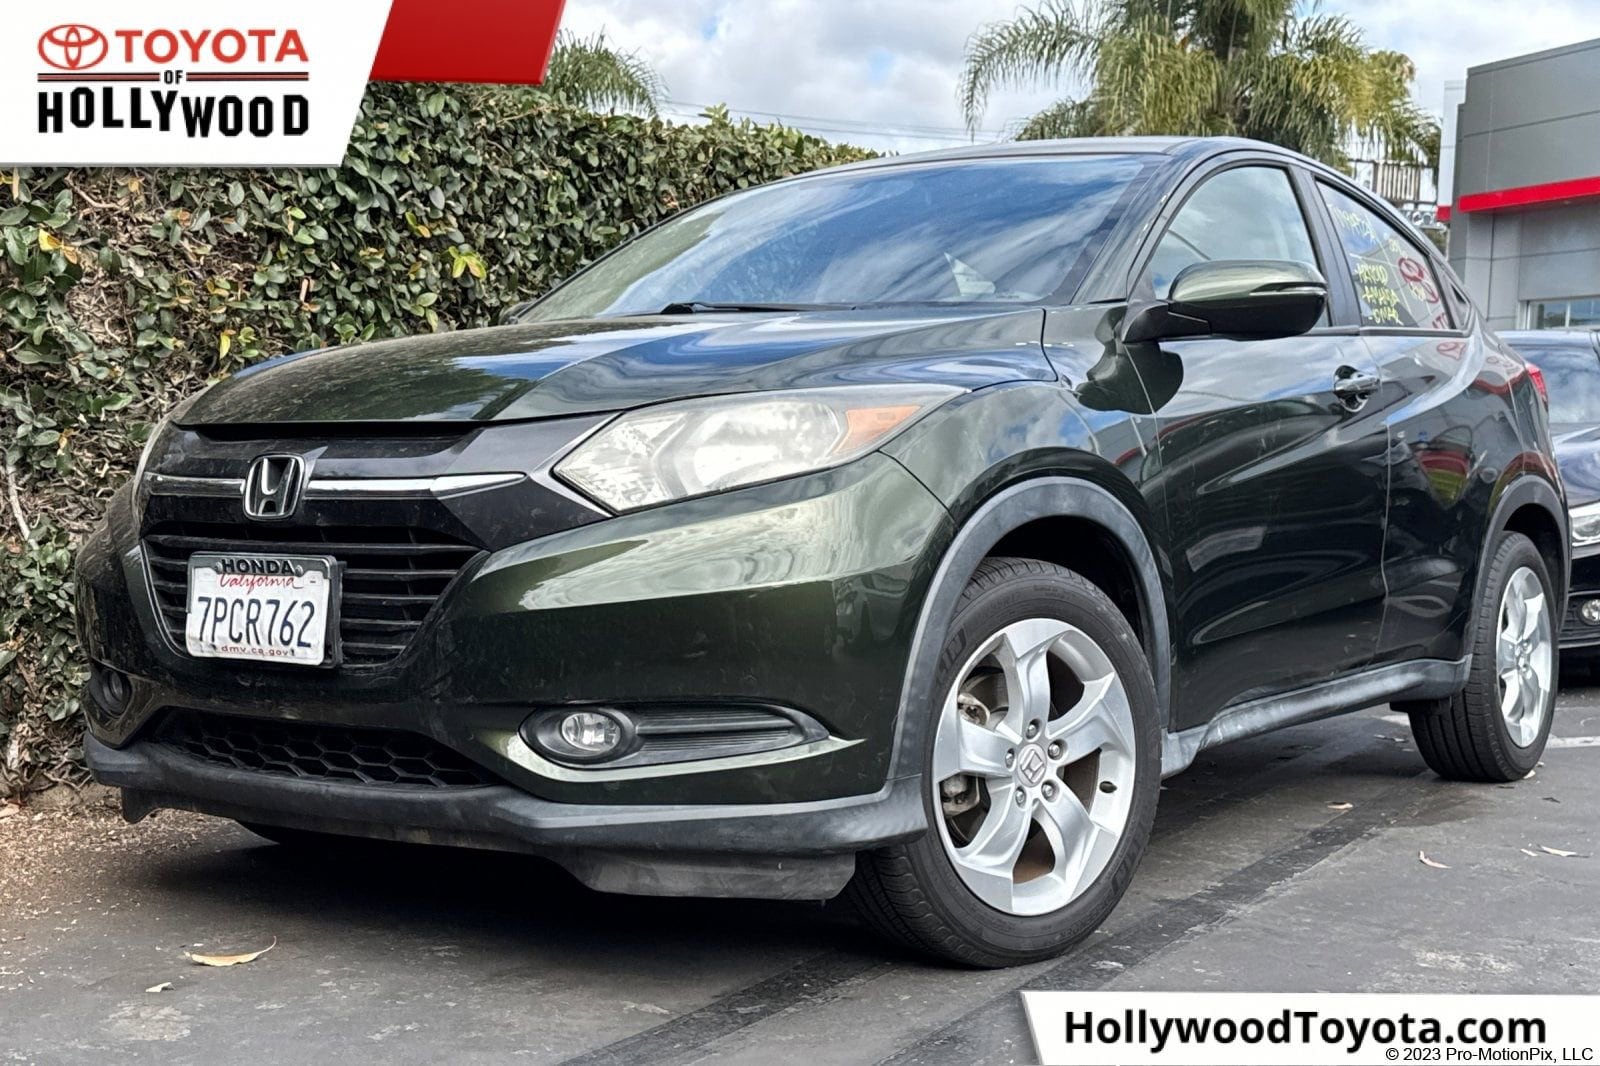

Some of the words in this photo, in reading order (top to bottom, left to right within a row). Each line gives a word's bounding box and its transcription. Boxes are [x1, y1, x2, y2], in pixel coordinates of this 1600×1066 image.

[221, 559, 296, 575] HONDA
[219, 573, 304, 595] California
[198, 596, 316, 648] 7PCR762
